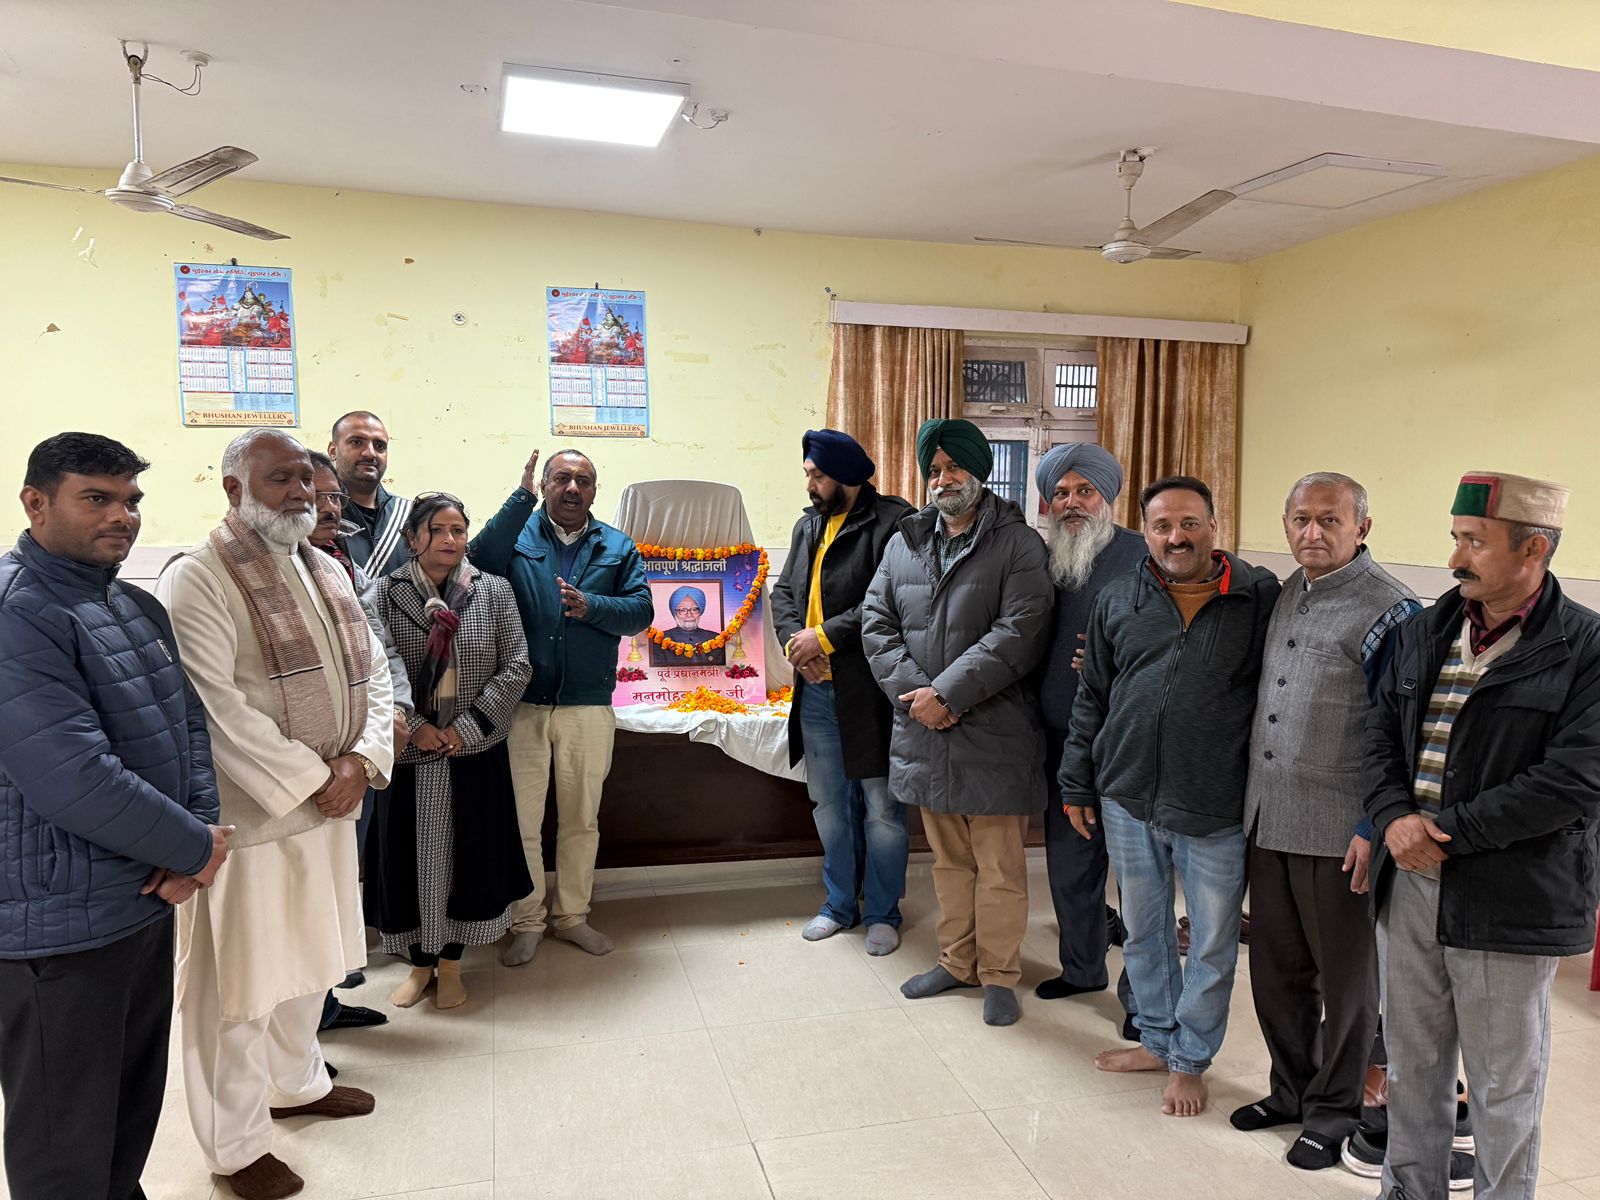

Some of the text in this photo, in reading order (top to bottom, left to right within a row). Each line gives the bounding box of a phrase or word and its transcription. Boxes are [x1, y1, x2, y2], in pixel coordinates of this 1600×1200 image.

[657, 667, 720, 682] पूर्व प्रधानमंत्री
[725, 685, 744, 699] जी
[1300, 1136, 1324, 1151] PUMA
